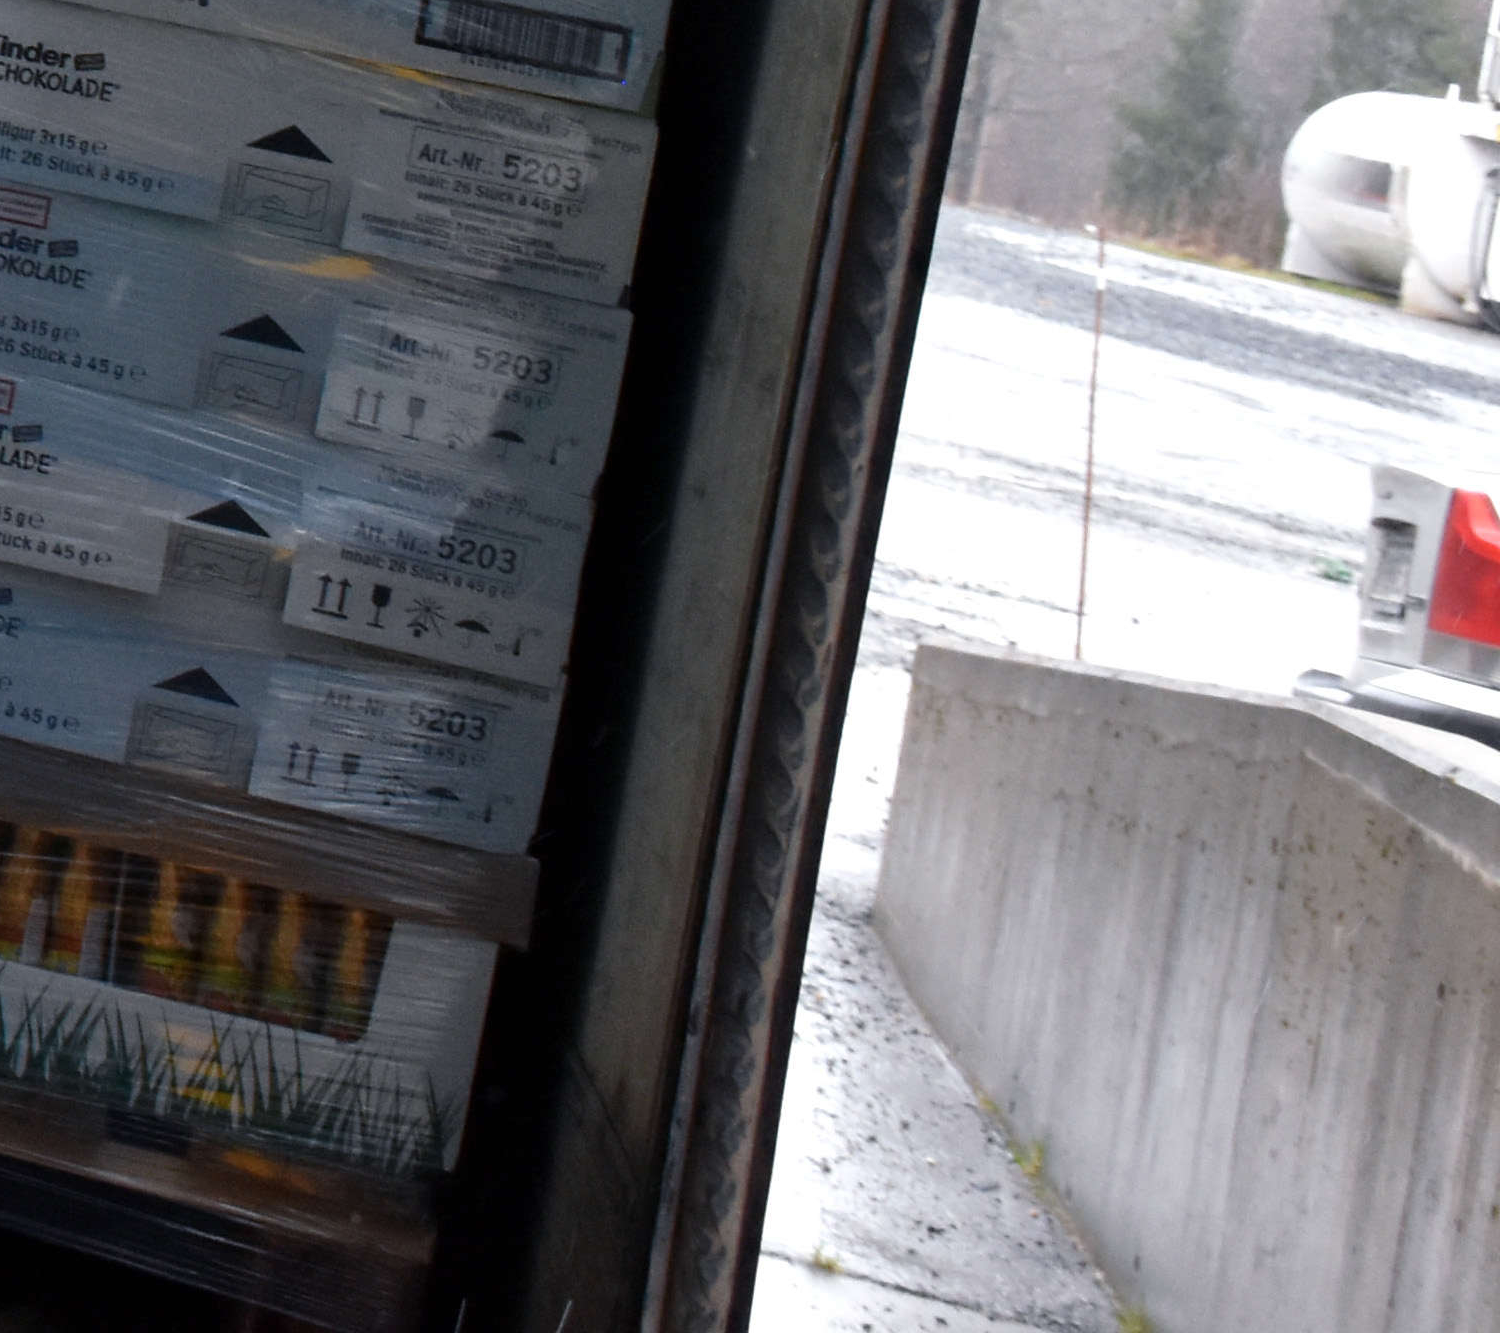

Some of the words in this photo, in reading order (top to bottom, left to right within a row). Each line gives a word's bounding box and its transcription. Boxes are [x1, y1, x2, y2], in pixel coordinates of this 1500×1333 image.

[39, 128, 78, 151] 3x15
[78, 138, 90, 156] g
[20, 149, 44, 168] 26
[115, 168, 139, 187] 45
[140, 175, 152, 193] g
[501, 152, 582, 194] 5203
[11, 314, 50, 339] 3x15
[50, 324, 62, 343] g
[19, 340, 68, 366] Stück
[86, 355, 110, 375] 45
[113, 363, 125, 381] g
[472, 345, 553, 385] 5203
[14, 510, 25, 529] g
[51, 541, 77, 561] 45
[78, 549, 90, 567] g
[436, 534, 518, 575] 5203
[19, 704, 45, 726] 45
[46, 713, 58, 731] g
[407, 700, 488, 744] 5203
